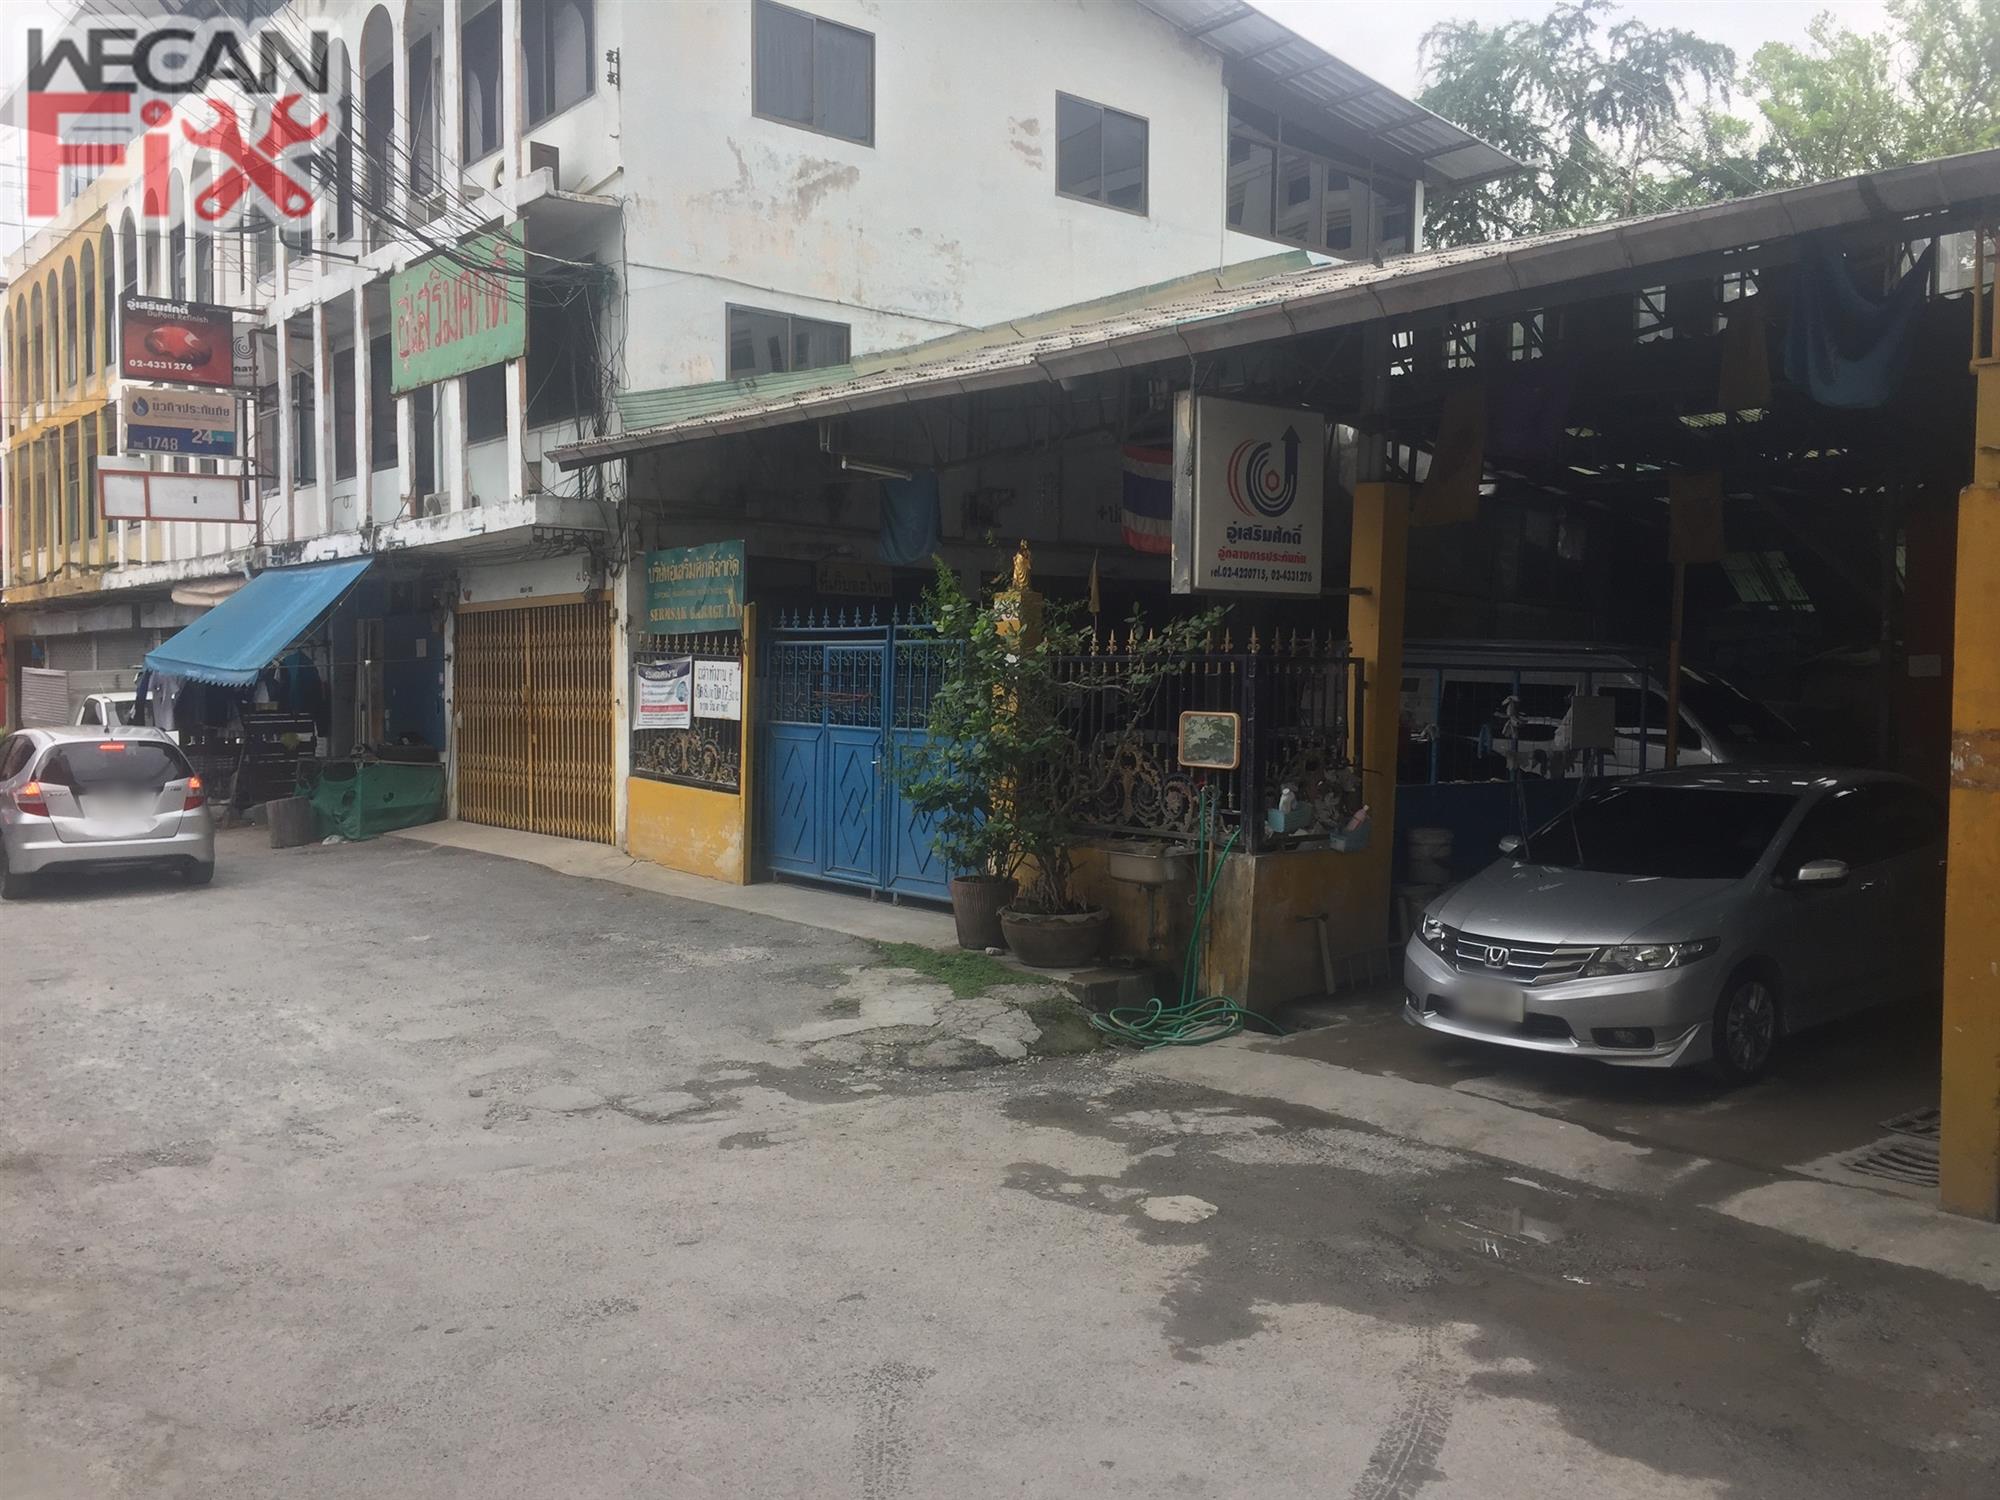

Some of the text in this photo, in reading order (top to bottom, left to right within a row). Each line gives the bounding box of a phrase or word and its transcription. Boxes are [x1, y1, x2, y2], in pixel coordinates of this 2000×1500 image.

[126, 298, 189, 315] อู่เสริมศักดิ์
[147, 310, 176, 320] DuPont
[129, 359, 193, 371] 02-4331276
[147, 436, 179, 451] 1748
[191, 428, 214, 445] 24
[1226, 521, 1303, 545] อู่เสริมศักดิ์
[1217, 546, 1307, 564] อู่กลางการประกันภัย
